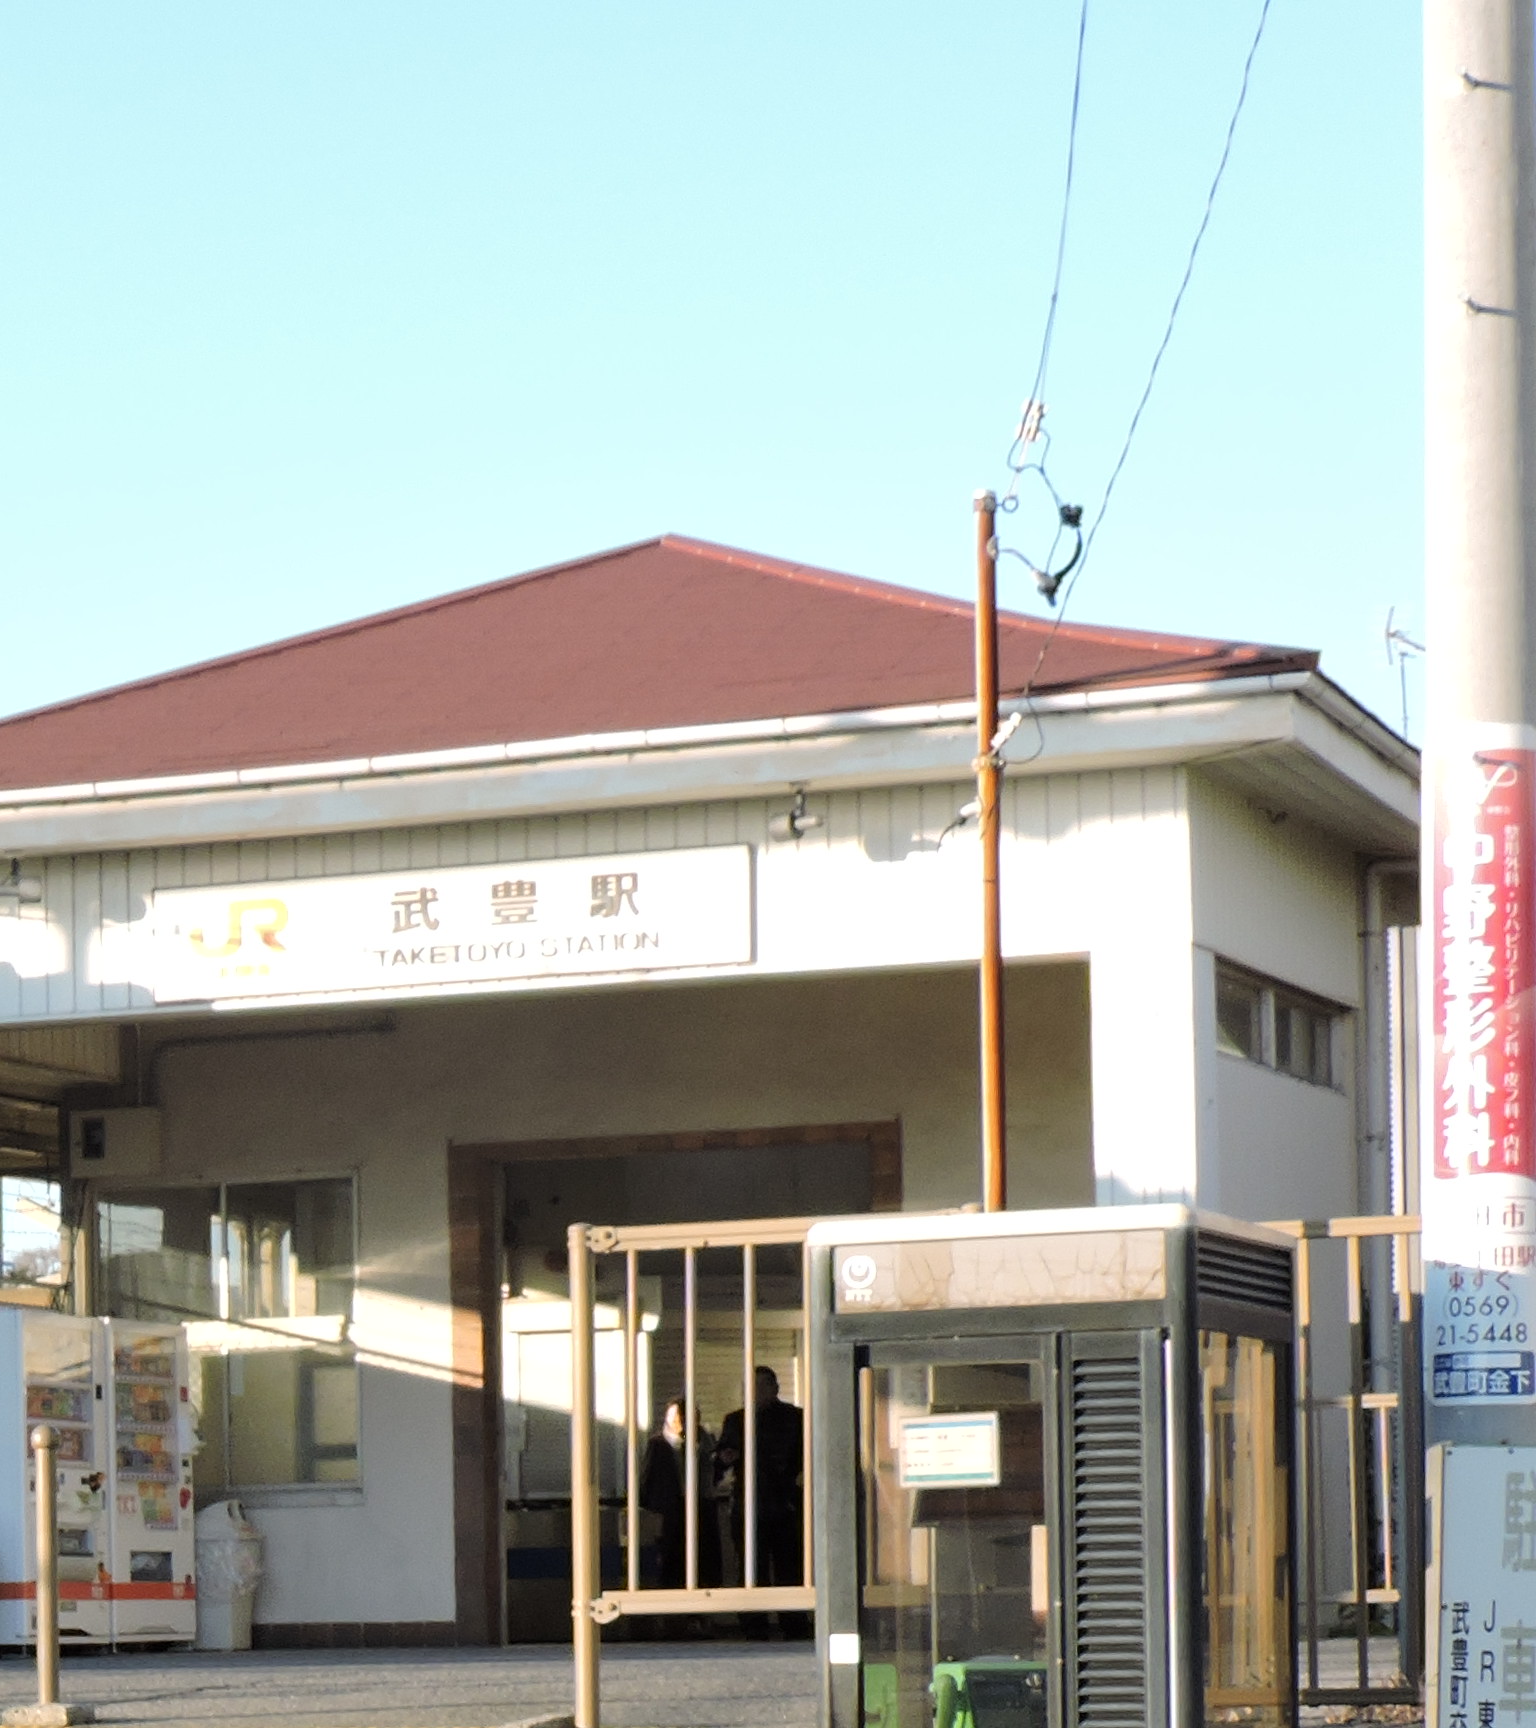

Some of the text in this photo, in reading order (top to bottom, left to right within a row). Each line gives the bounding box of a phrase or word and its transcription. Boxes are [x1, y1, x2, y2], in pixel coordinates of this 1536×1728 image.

[390, 871, 640, 934] 武豊駅
[190, 898, 289, 957] JR
[373, 931, 660, 967] TAKETOYO STATION
[1441, 1294, 1520, 1319] (0569)
[1437, 1322, 1529, 1348] 21-5448
